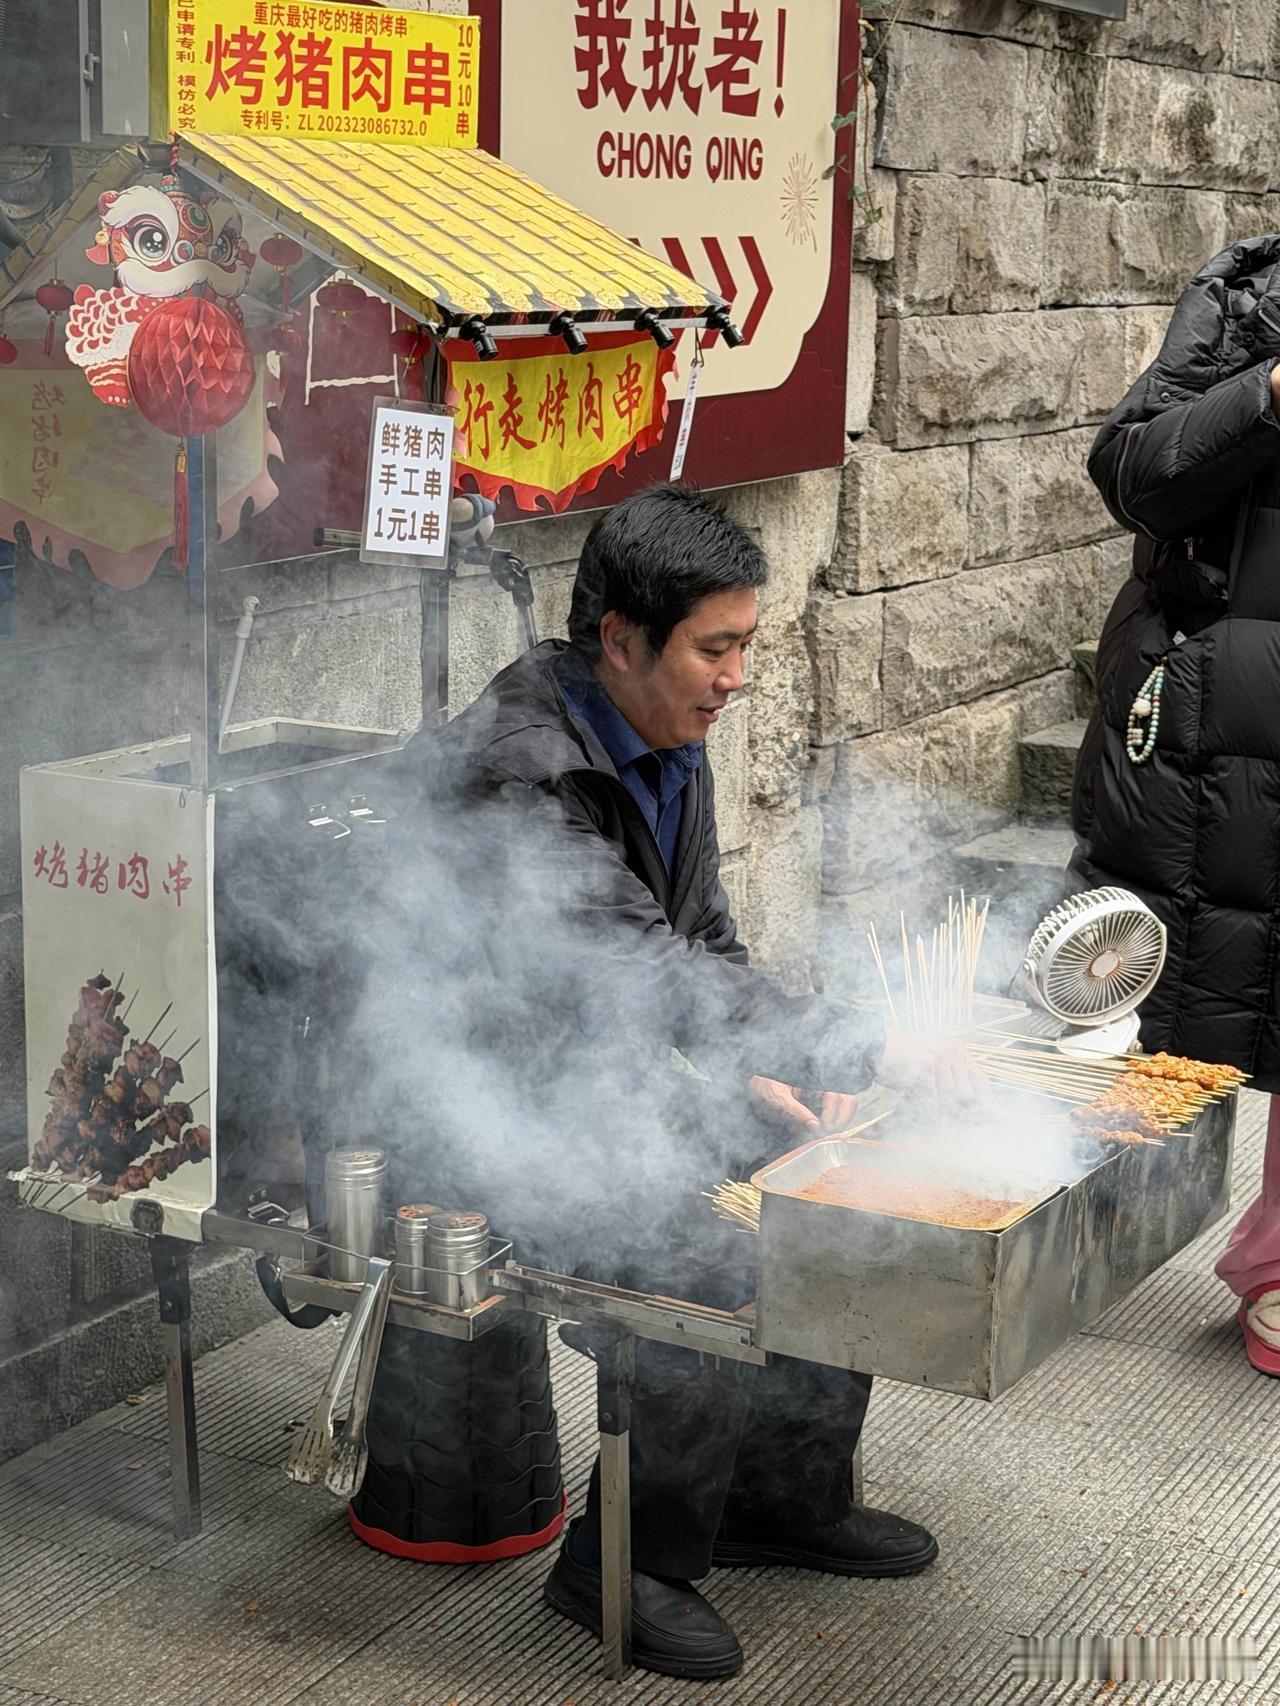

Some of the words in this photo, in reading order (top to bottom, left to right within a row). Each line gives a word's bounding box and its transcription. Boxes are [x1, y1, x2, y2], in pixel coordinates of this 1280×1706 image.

[253, 2, 408, 38] 重庆最好吃的猪肉烤串
[204, 23, 452, 116] 烤猪肉串
[177, 75, 196, 129] 模仿必究
[597, 130, 692, 180] CHONG
[706, 136, 764, 183] QING
[460, 353, 643, 461] 行走烤肉串
[381, 420, 446, 461] 鲜猪肉
[378, 463, 443, 501] 手工串
[373, 507, 441, 545] 1元1串
[34, 839, 193, 907] 烤猪肉串
